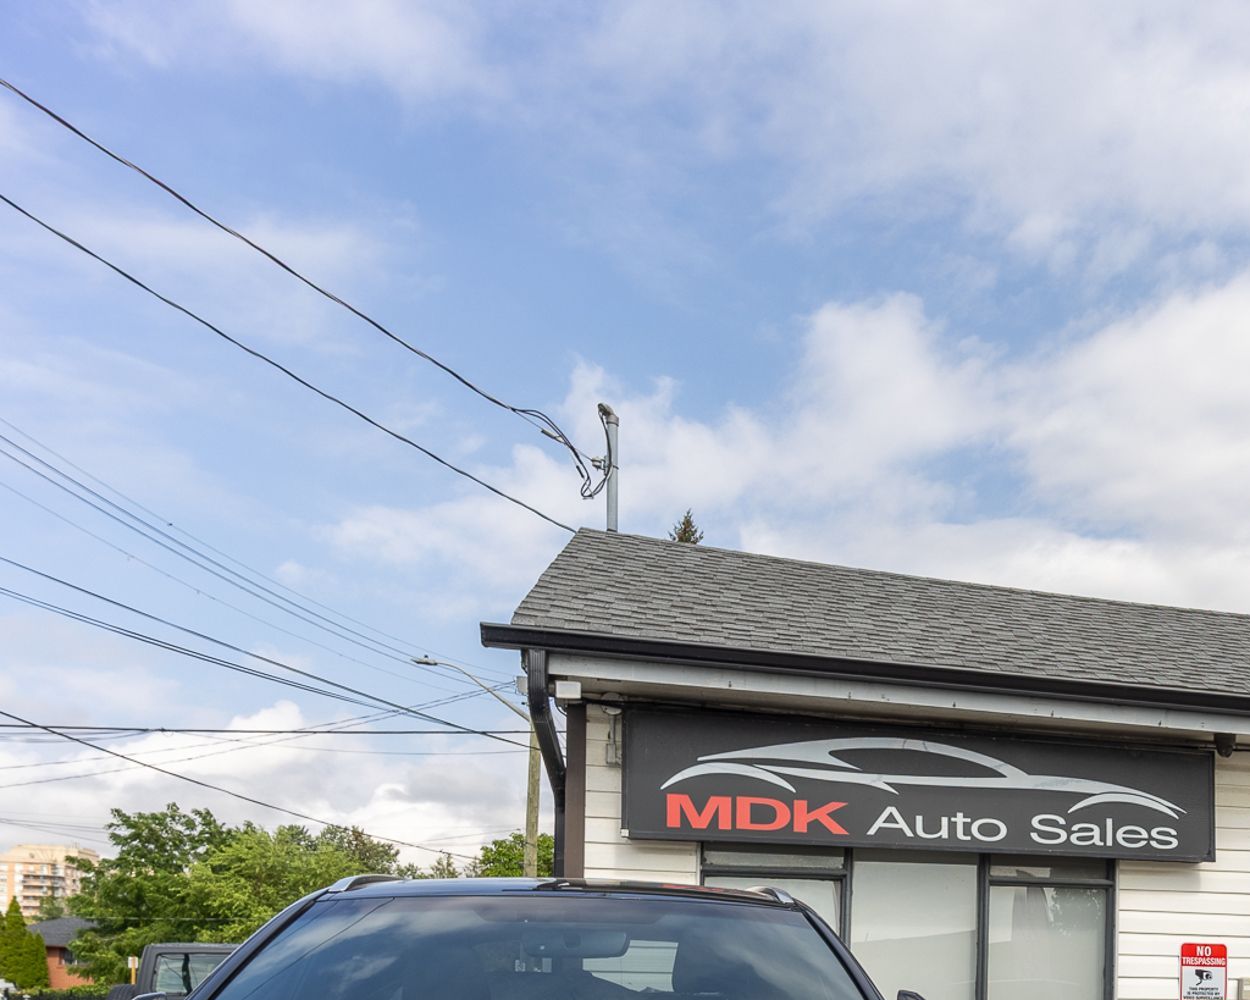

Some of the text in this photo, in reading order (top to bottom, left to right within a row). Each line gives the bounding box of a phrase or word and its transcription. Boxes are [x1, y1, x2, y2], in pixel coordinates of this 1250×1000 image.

[666, 793, 1179, 850] MDK Auto Sales
[1196, 946, 1212, 956] NO
[1182, 957, 1226, 965] TRESPASSING
